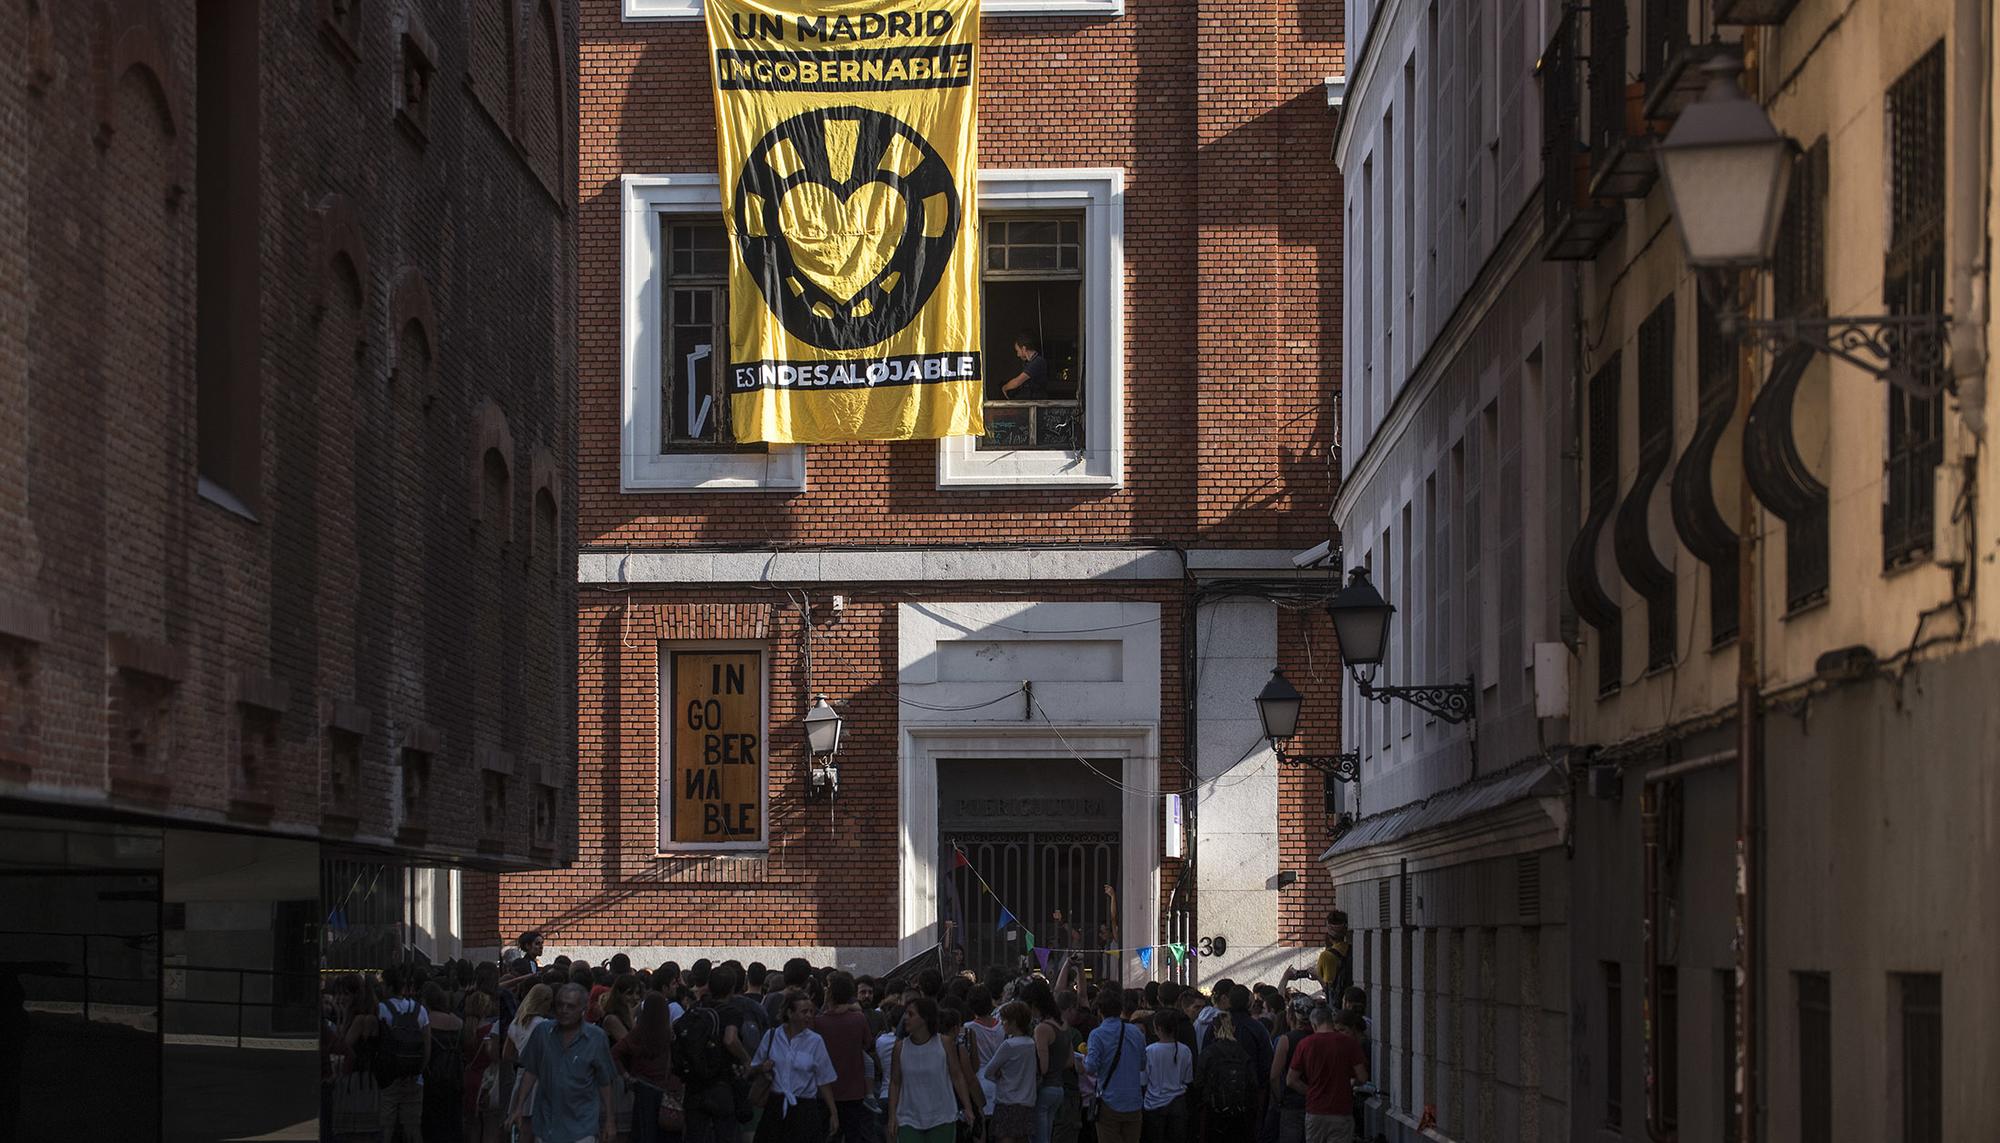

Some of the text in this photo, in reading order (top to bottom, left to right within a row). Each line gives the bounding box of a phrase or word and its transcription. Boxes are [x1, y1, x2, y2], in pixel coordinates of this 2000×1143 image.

[731, 9, 954, 43] UN MADRID
[720, 54, 969, 84] INGOBERNABLE
[735, 367, 756, 388] ES
[711, 663, 745, 695] IN
[687, 699, 721, 731] GO
[704, 733, 757, 765] BER
[703, 803, 756, 835] BLE
